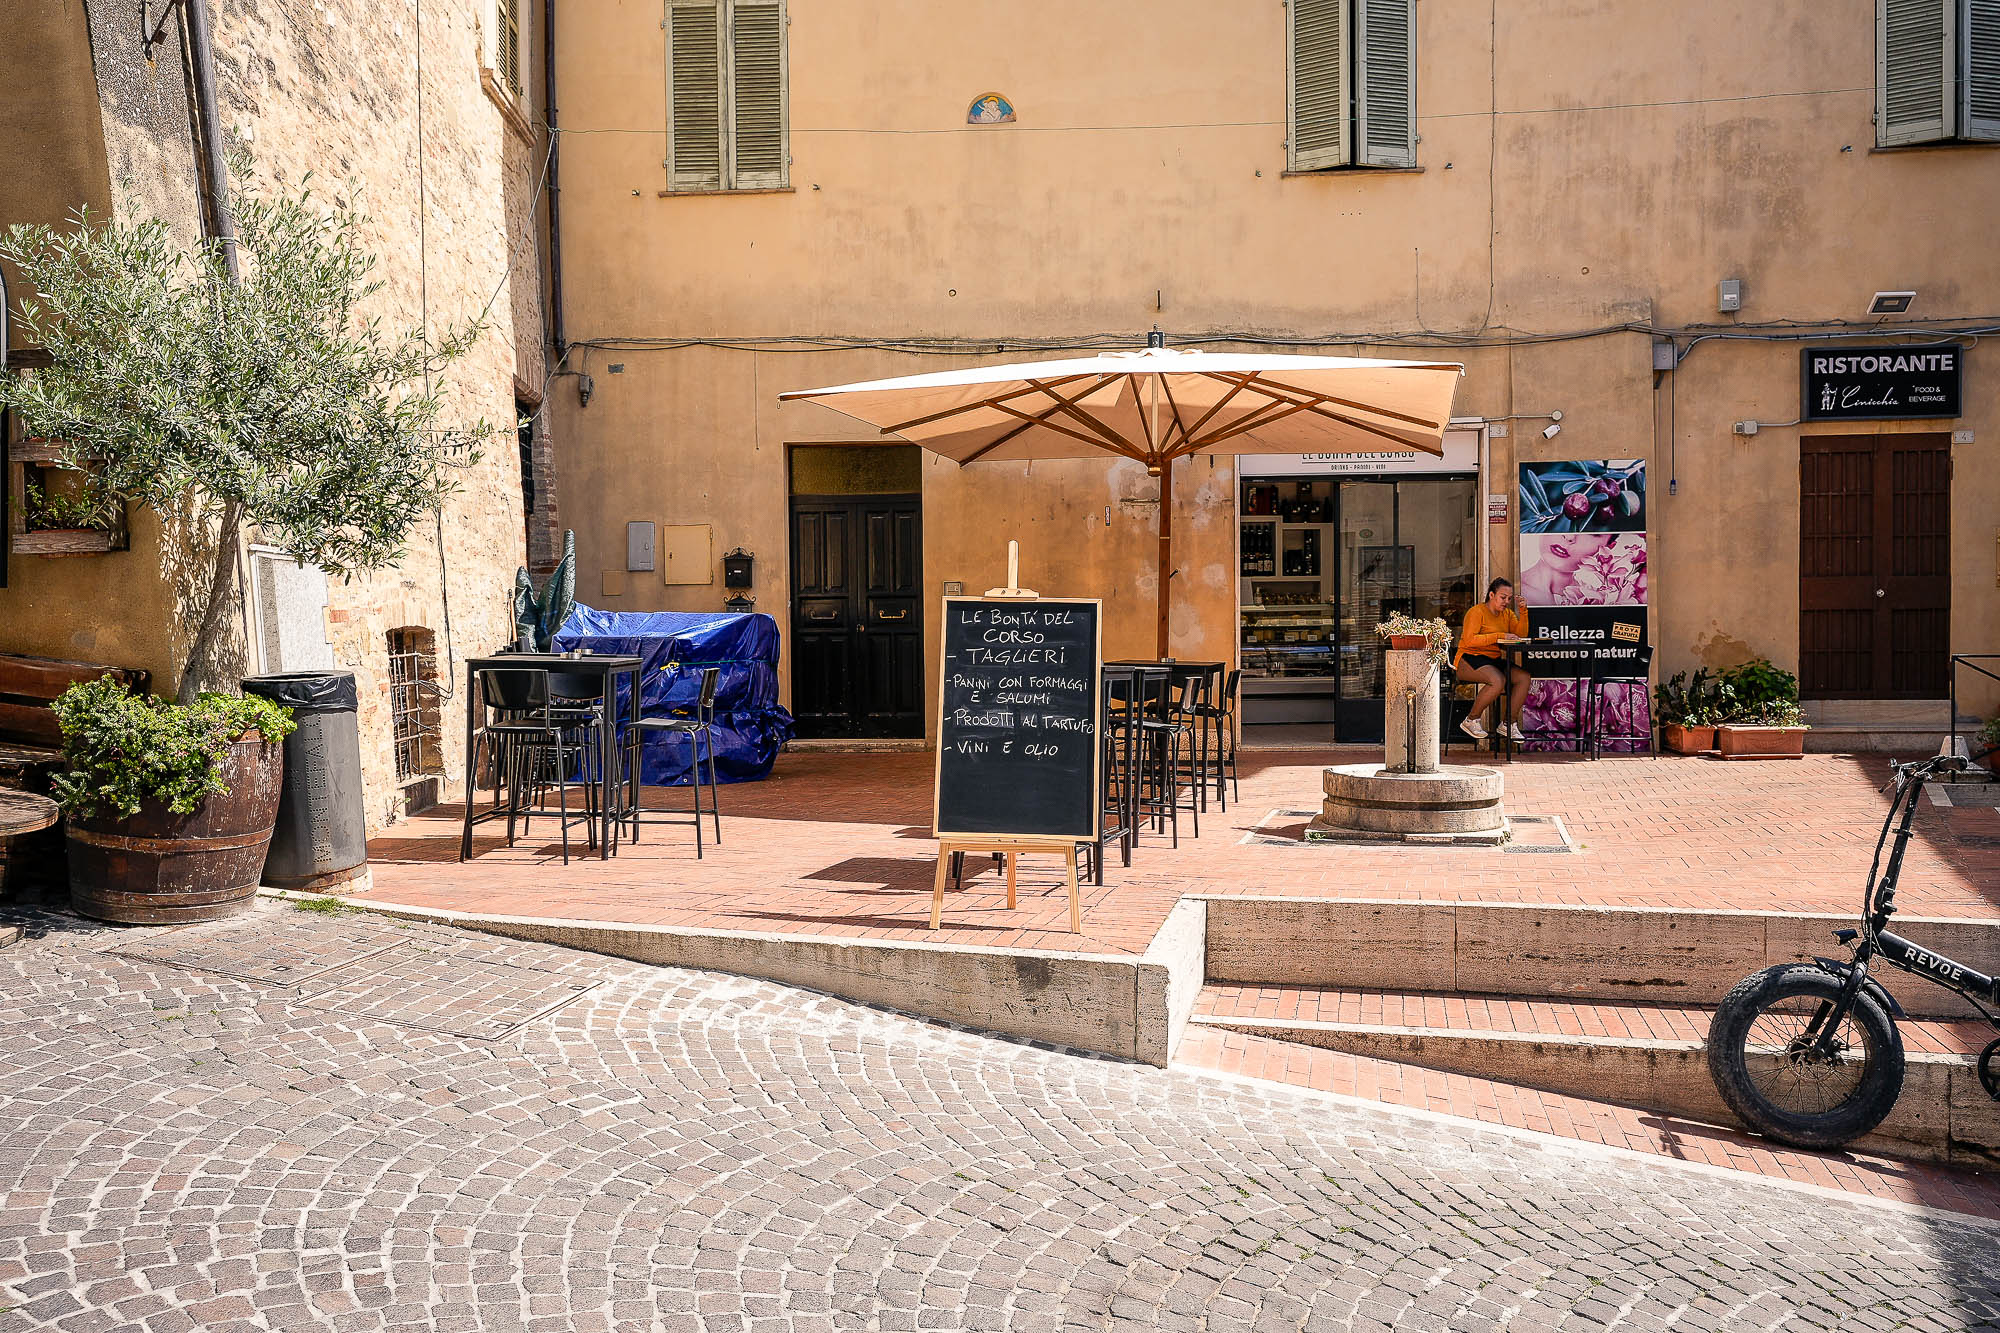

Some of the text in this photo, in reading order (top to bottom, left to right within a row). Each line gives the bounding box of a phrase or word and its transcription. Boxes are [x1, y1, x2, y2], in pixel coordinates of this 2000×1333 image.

[1813, 354, 1954, 374] RISTORANTE
[1908, 395, 1947, 403] BEVERAGE
[961, 610, 984, 624] LE
[1043, 610, 1074, 626] DEL
[983, 628, 1045, 644] CORSO
[1538, 625, 1605, 640] Bellezza
[998, 675, 1023, 688] CON
[970, 690, 981, 703] E
[1022, 715, 1038, 728] AL
[1042, 716, 1094, 734] TARTUFO
[1002, 741, 1014, 754] E
[1904, 946, 1964, 982] REVOE
